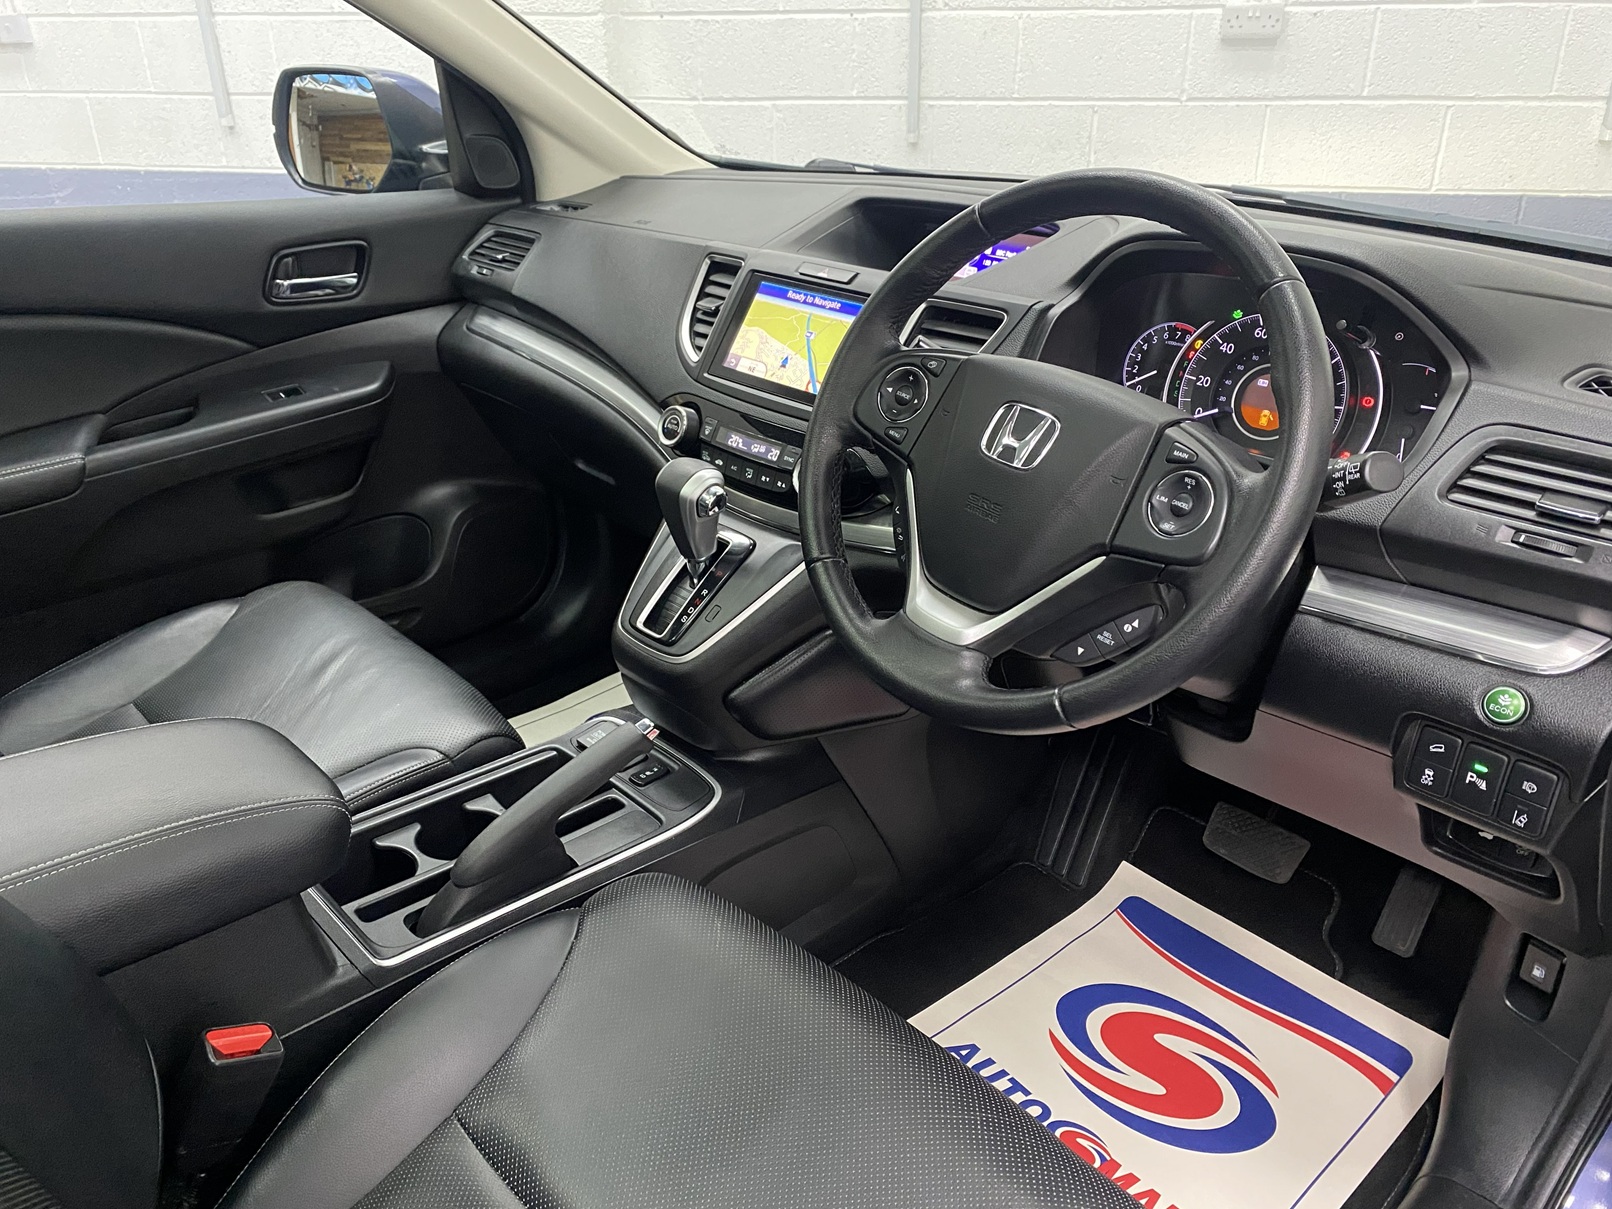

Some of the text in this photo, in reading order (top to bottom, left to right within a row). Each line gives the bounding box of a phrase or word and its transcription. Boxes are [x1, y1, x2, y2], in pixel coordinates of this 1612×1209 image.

[787, 290, 842, 310] Ready to Navigate
[1151, 336, 1158, 344] 5
[1219, 342, 1235, 354] 40
[1196, 376, 1211, 387] 20
[888, 430, 901, 438] MENU
[767, 448, 780, 462] 20
[783, 455, 795, 463] SYNC
[1173, 450, 1189, 460] MAIN
[1348, 472, 1361, 480] REAR
[1184, 477, 1197, 486] RES
[1336, 481, 1344, 489] ON
[1156, 494, 1169, 503] LIM
[1171, 499, 1189, 510] CANCEL
[700, 589, 709, 597] R
[687, 606, 695, 614] D
[680, 615, 688, 623] S
[1096, 634, 1115, 646] RESET
[1103, 631, 1113, 640] SEL
[1489, 703, 1514, 716] ECON
[1420, 778, 1433, 786] OFF
